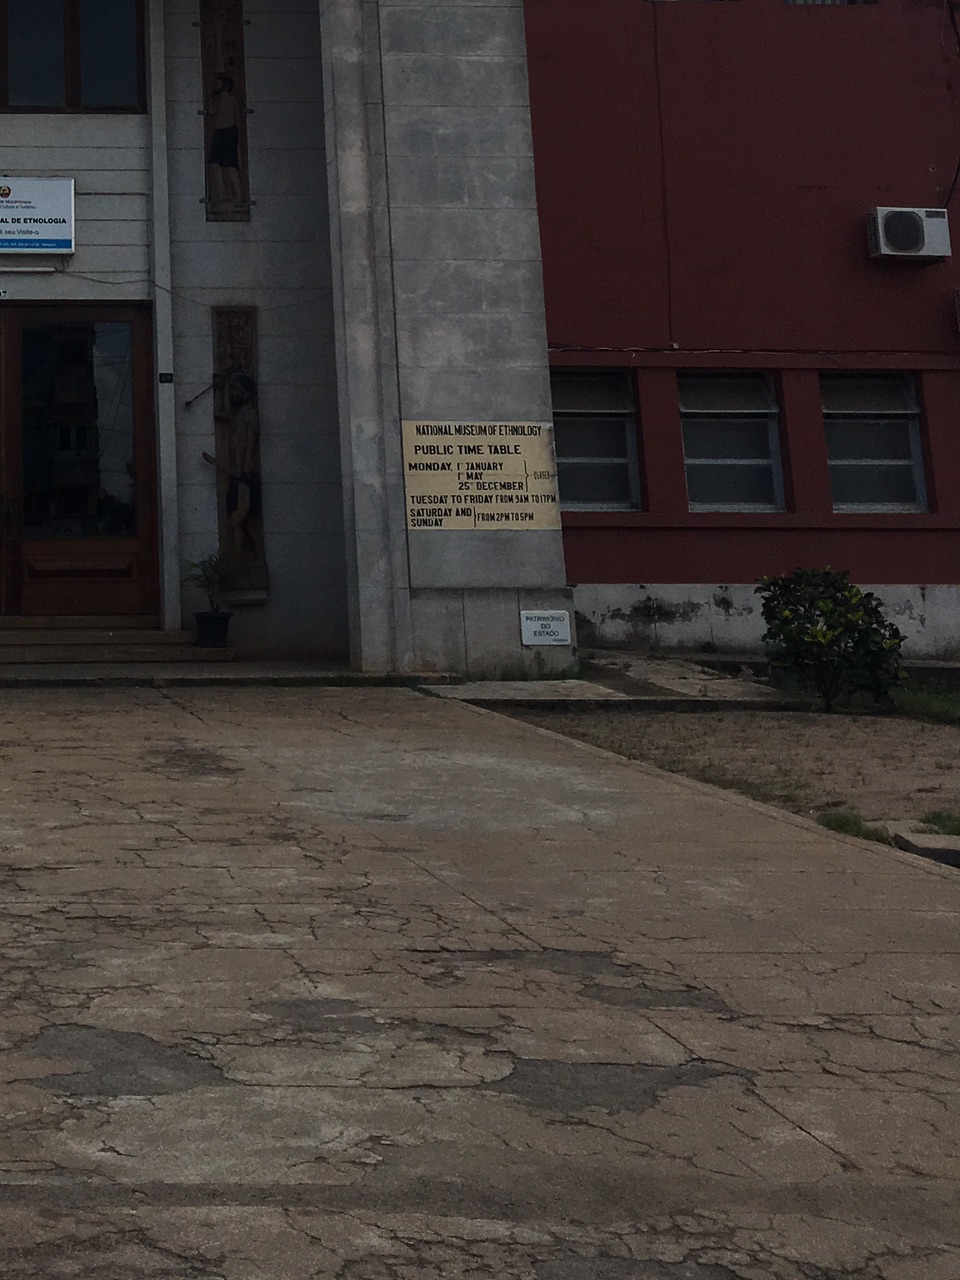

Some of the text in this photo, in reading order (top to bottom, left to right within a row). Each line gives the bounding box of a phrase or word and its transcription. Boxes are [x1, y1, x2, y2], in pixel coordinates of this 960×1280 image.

[415, 424, 542, 437] NATIONAL MUSEUM OF ETHNOLOGY
[414, 445, 522, 455] PUBLIC TIME TABLE
[465, 462, 503, 471] JANUARY
[466, 472, 483, 480] MAY
[476, 482, 524, 491] DECEMBER
[410, 495, 448, 505] TUESDAY
[451, 495, 462, 504] TO
[464, 495, 493, 504] FRIDAY
[495, 494, 514, 504] FROM
[531, 494, 539, 504] TO
[410, 508, 472, 518] SATURDAY AND
[477, 512, 534, 522] FROM 2PM TO 5PM
[411, 518, 444, 527] SUNDAY
